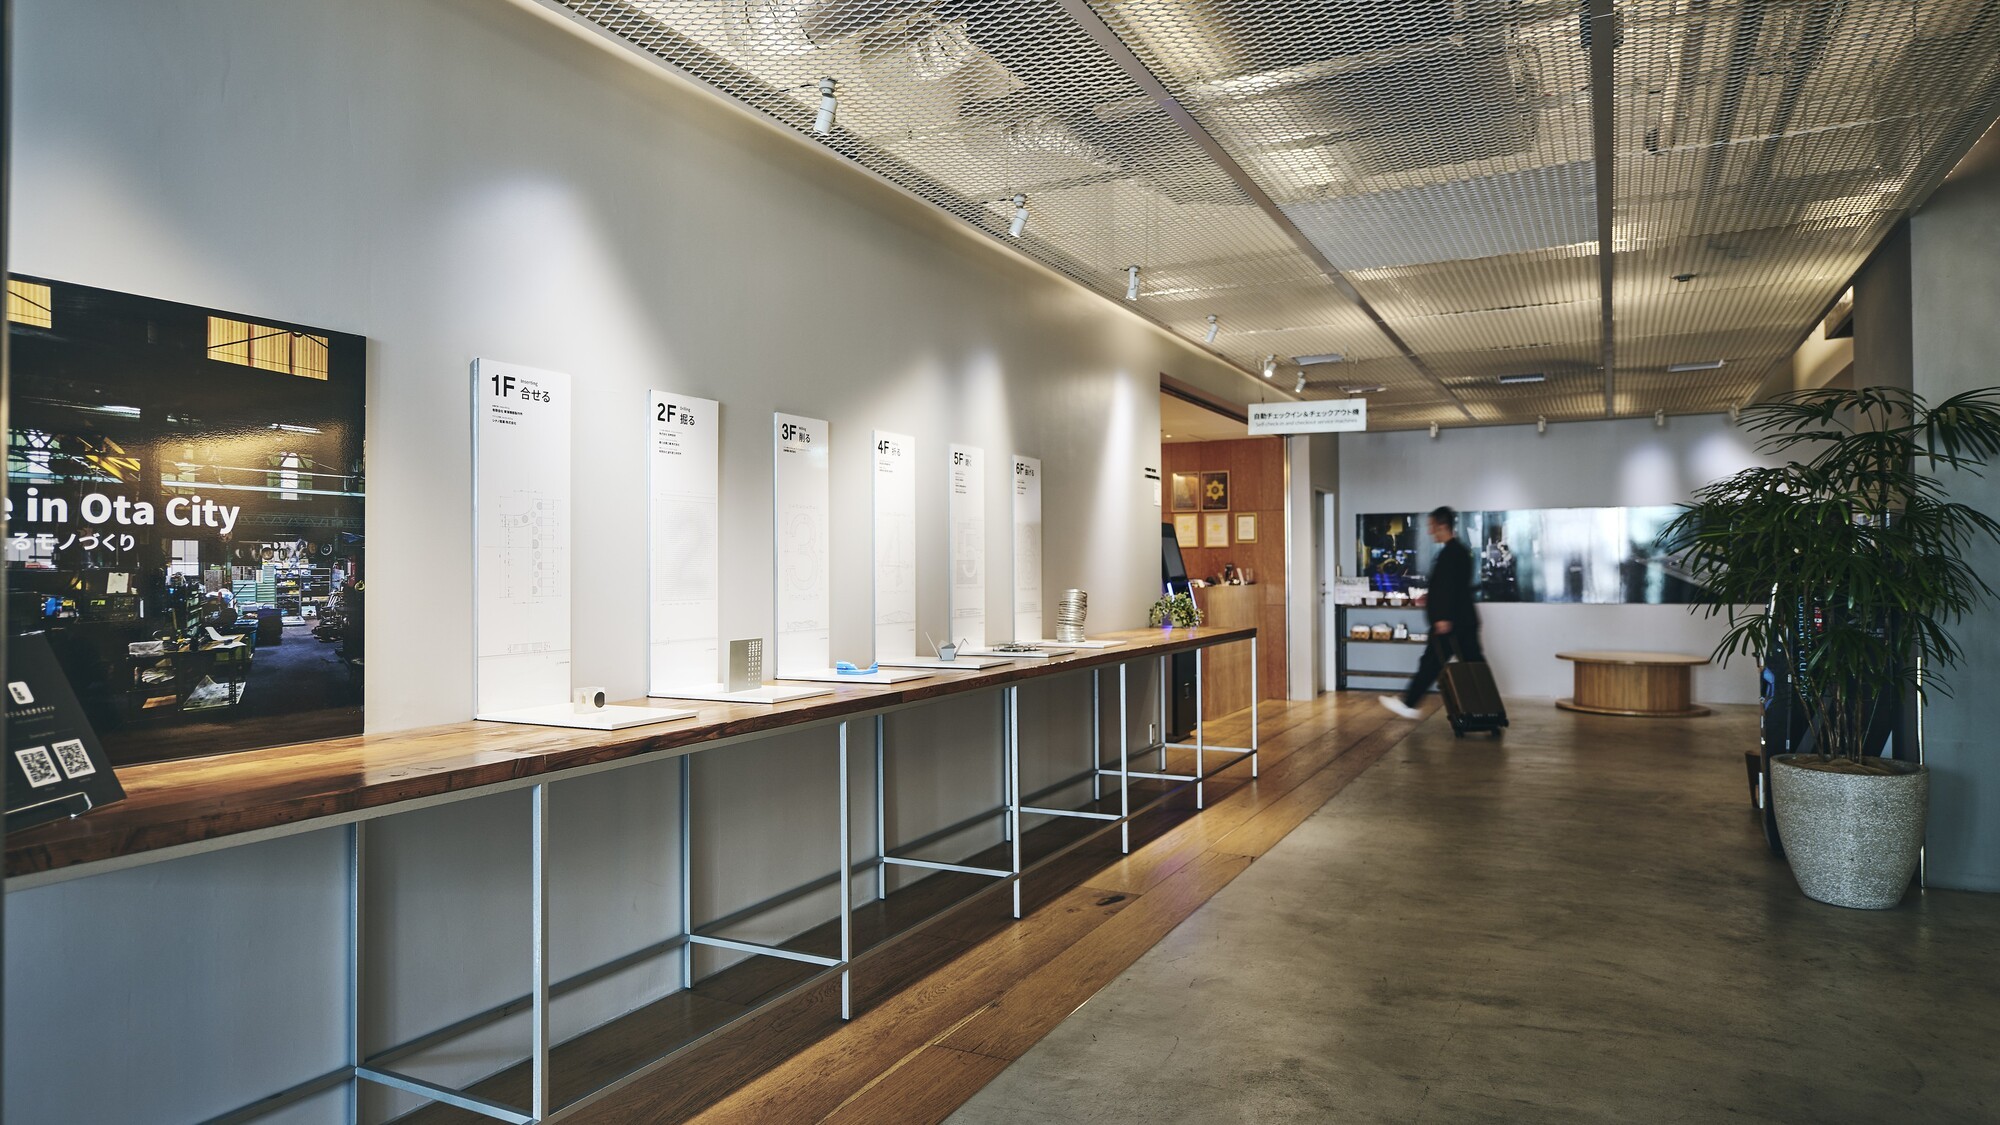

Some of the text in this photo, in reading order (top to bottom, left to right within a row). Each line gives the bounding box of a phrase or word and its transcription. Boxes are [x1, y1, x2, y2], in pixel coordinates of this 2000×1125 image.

[492, 374, 516, 397] 1F
[520, 386, 551, 403] 合せる
[657, 403, 677, 423] 2F
[680, 413, 696, 426] 掘る
[782, 423, 797, 440] 3F
[798, 432, 811, 444] 削る
[878, 439, 889, 455] 4F
[954, 452, 964, 466] 5F
[1015, 462, 1025, 475] 6F
[27, 487, 68, 522] in
[80, 493, 155, 525] Ota
[165, 495, 241, 535] City
[4, 532, 136, 552] るモノづくり
